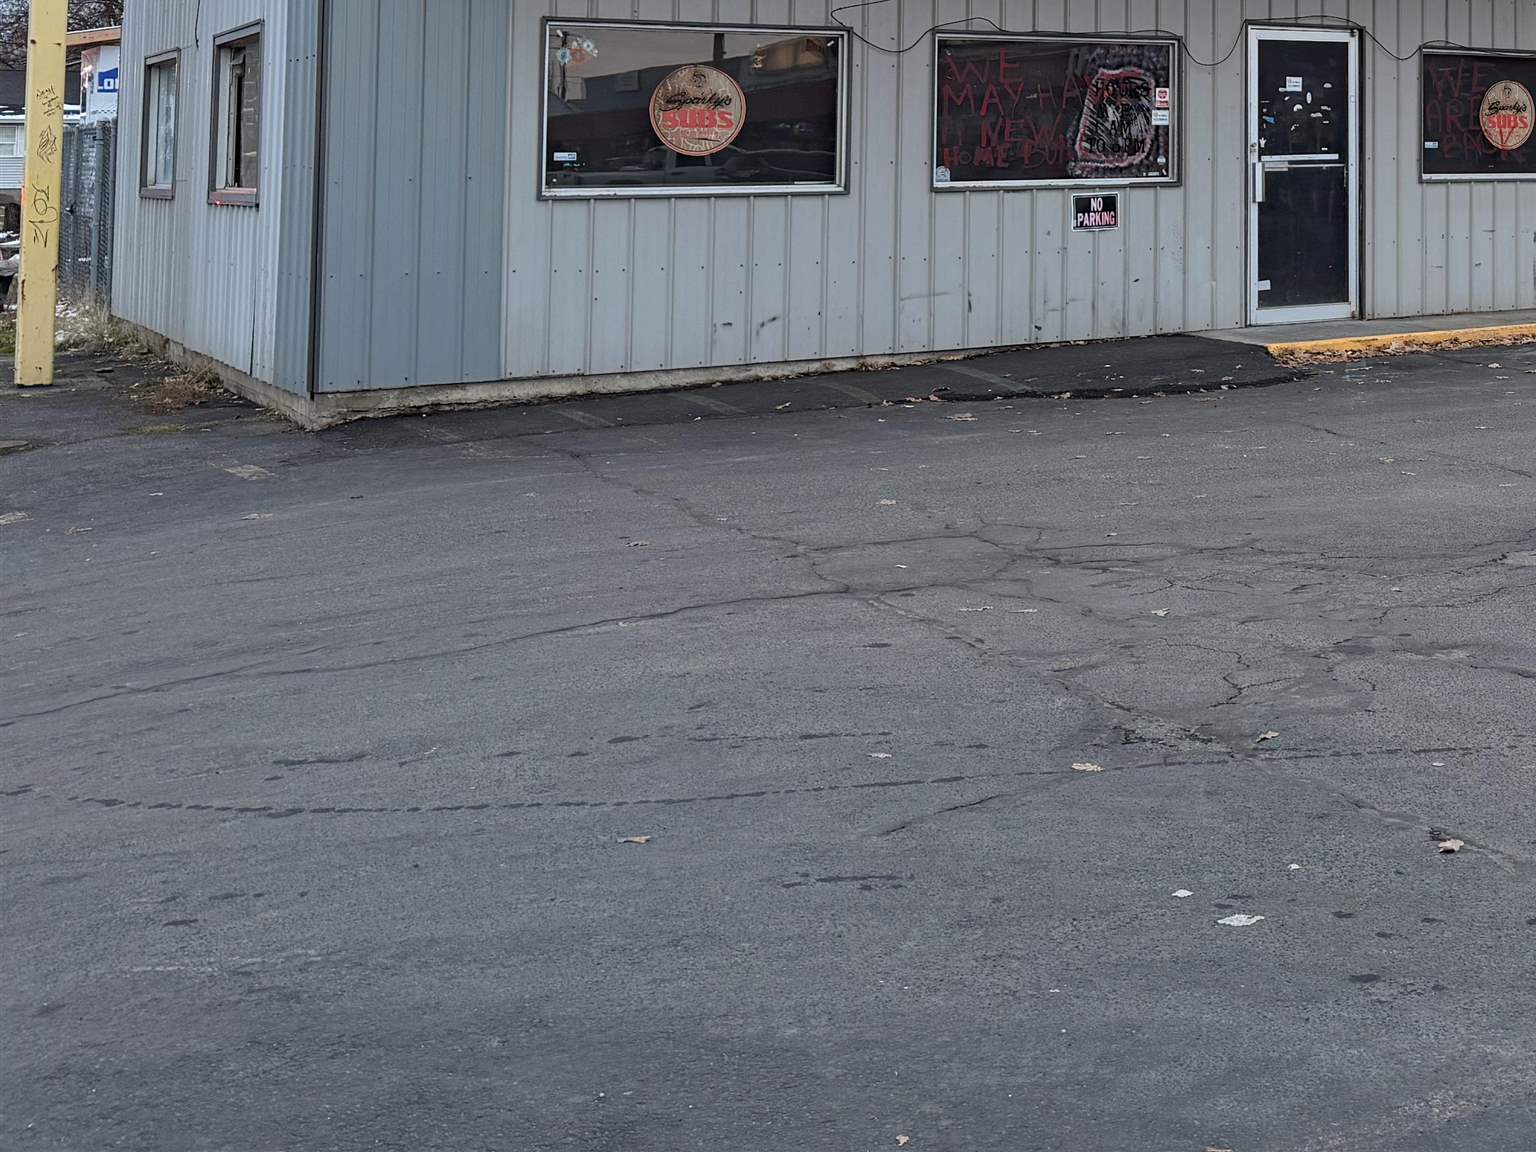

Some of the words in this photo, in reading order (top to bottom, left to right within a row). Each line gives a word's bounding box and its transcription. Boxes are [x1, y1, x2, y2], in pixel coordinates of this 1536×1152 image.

[945, 48, 1023, 85] WE
[943, 81, 1025, 119] MAY
[661, 110, 735, 129] SUBS
[1487, 114, 1530, 129] SUBS
[1090, 197, 1103, 212] NO
[1077, 211, 1116, 227] PARKING
